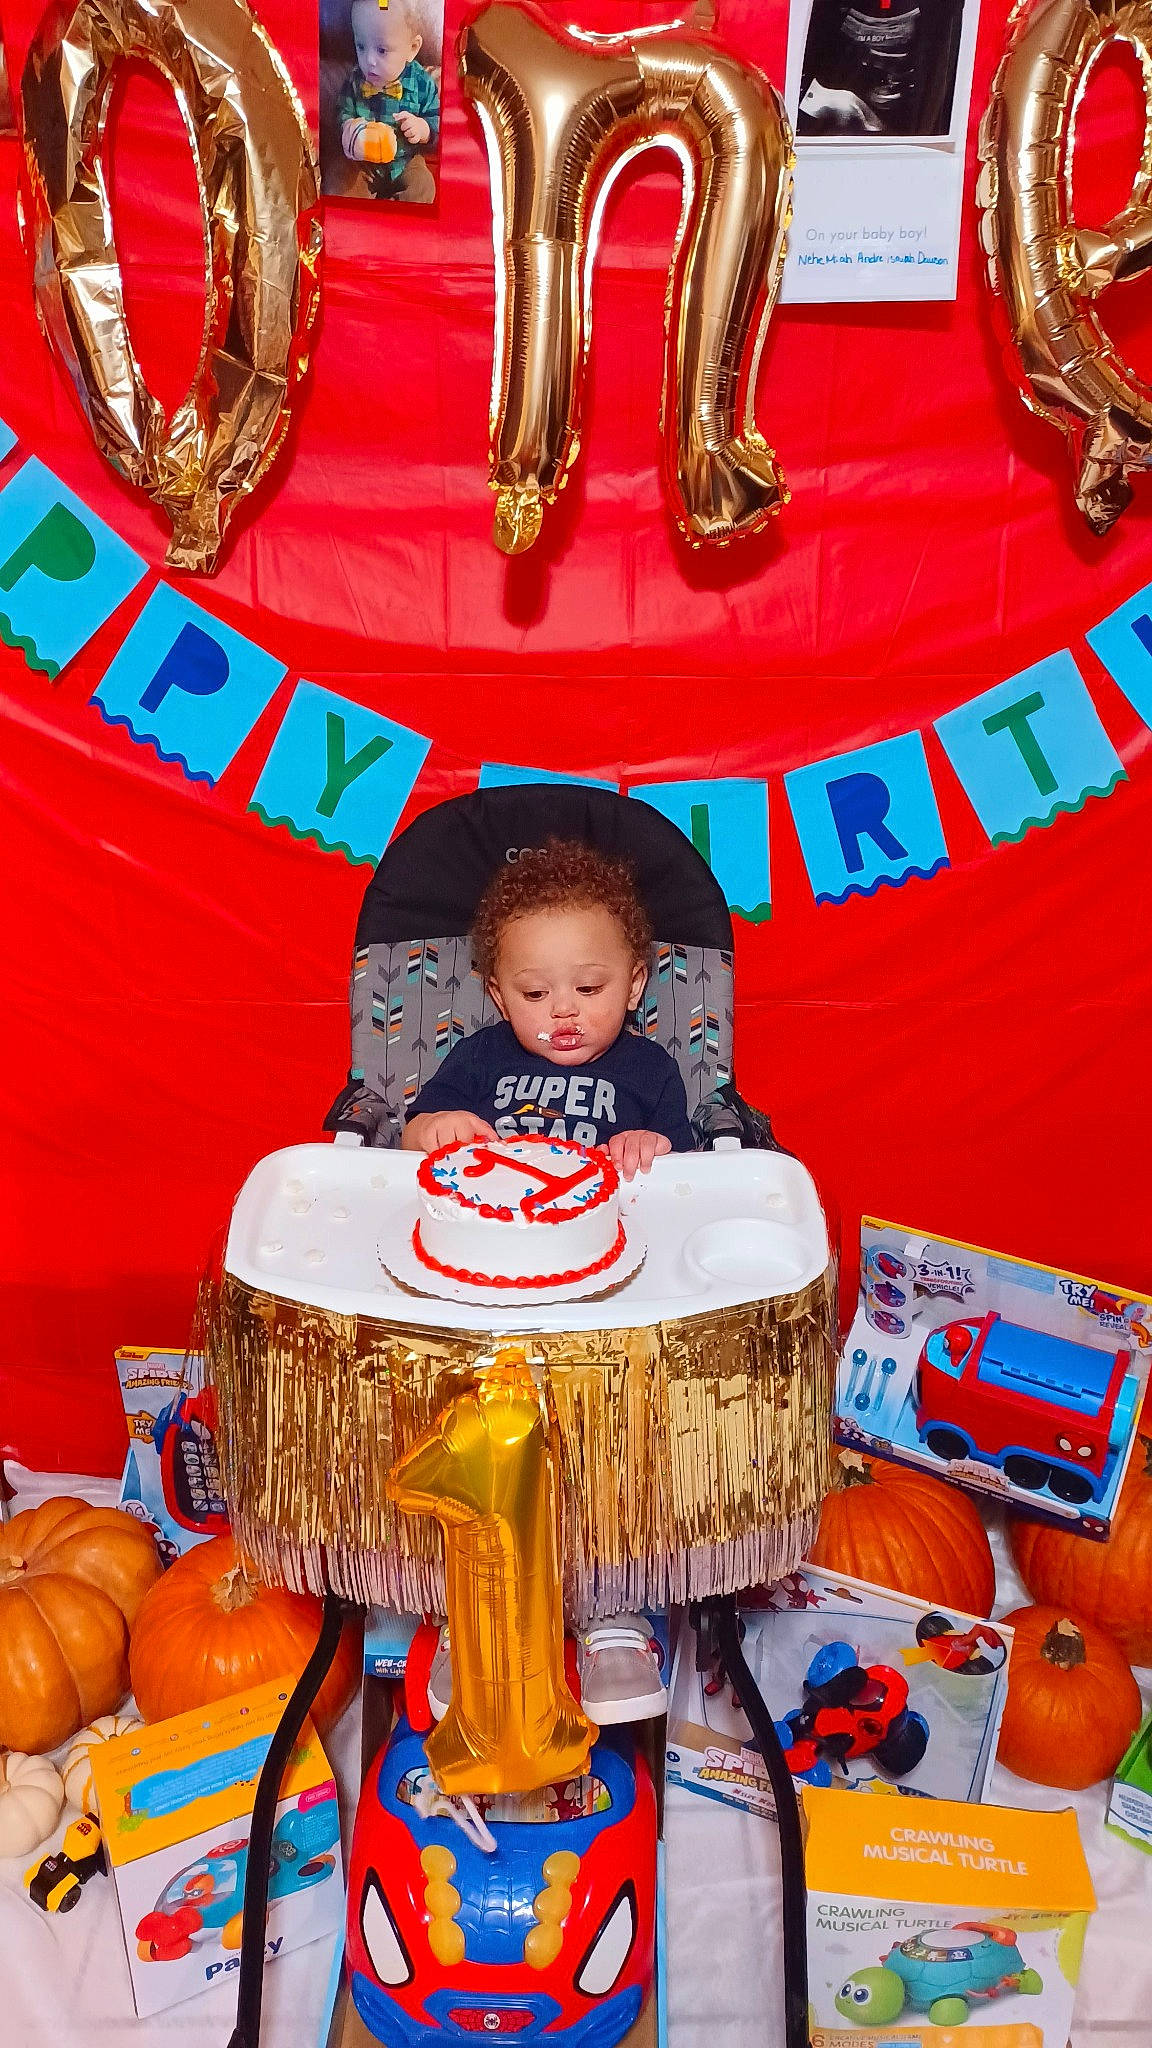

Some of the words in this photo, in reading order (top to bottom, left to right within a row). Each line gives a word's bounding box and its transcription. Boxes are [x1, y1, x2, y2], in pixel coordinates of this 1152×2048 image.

[806, 228, 825, 241] On
[830, 231, 858, 243] your
[862, 225, 894, 243] baby
[899, 225, 928, 241] boy!
[857, 251, 884, 264] Andre
[493, 1074, 618, 1124] SUPER
[918, 1263, 962, 1280] 3-IN-1!
[1060, 1280, 1098, 1298] TRY
[1069, 1295, 1095, 1308] ME!
[1099, 1313, 1122, 1323] SPIN
[125, 1379, 161, 1389] AMAZING
[134, 1419, 153, 1428] TRY
[699, 1767, 758, 1787] AMAZING
[890, 1827, 995, 1853] CRAWLING
[863, 1844, 953, 1867] MUSICAL
[957, 1852, 1029, 1876] TURTLE
[817, 1904, 905, 1918] CRAWLING
[815, 1917, 890, 1932] MUSICAL
[896, 1919, 952, 1929] TURTLE
[205, 1936, 284, 1981] Pay
[811, 2033, 825, 2048] 6
